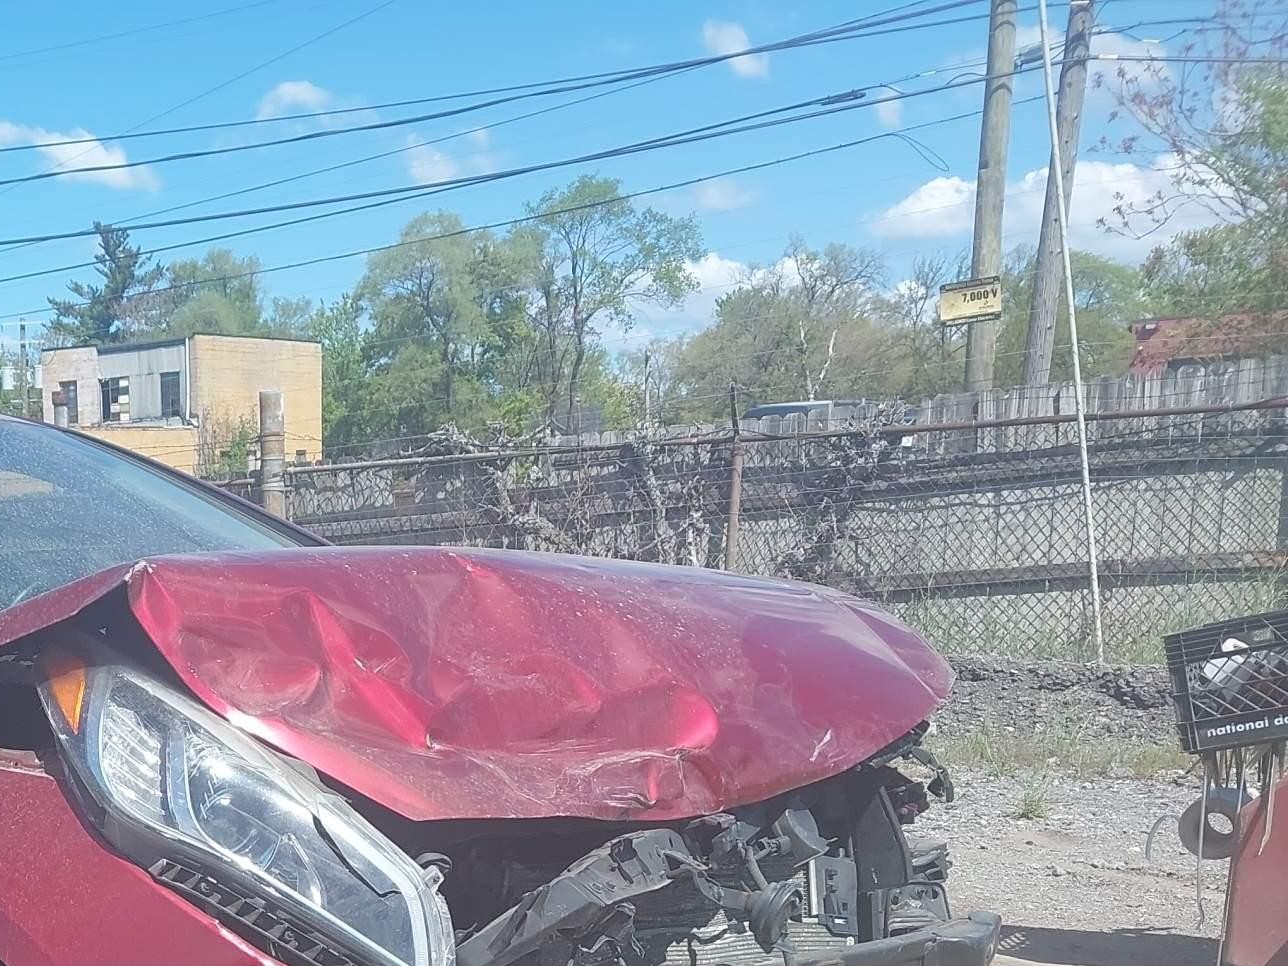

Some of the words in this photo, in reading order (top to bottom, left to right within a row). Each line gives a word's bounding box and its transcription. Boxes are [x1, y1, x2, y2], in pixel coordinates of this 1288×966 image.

[961, 289, 989, 304] 7,000
[991, 288, 998, 298] V
[1207, 716, 1269, 737] national
